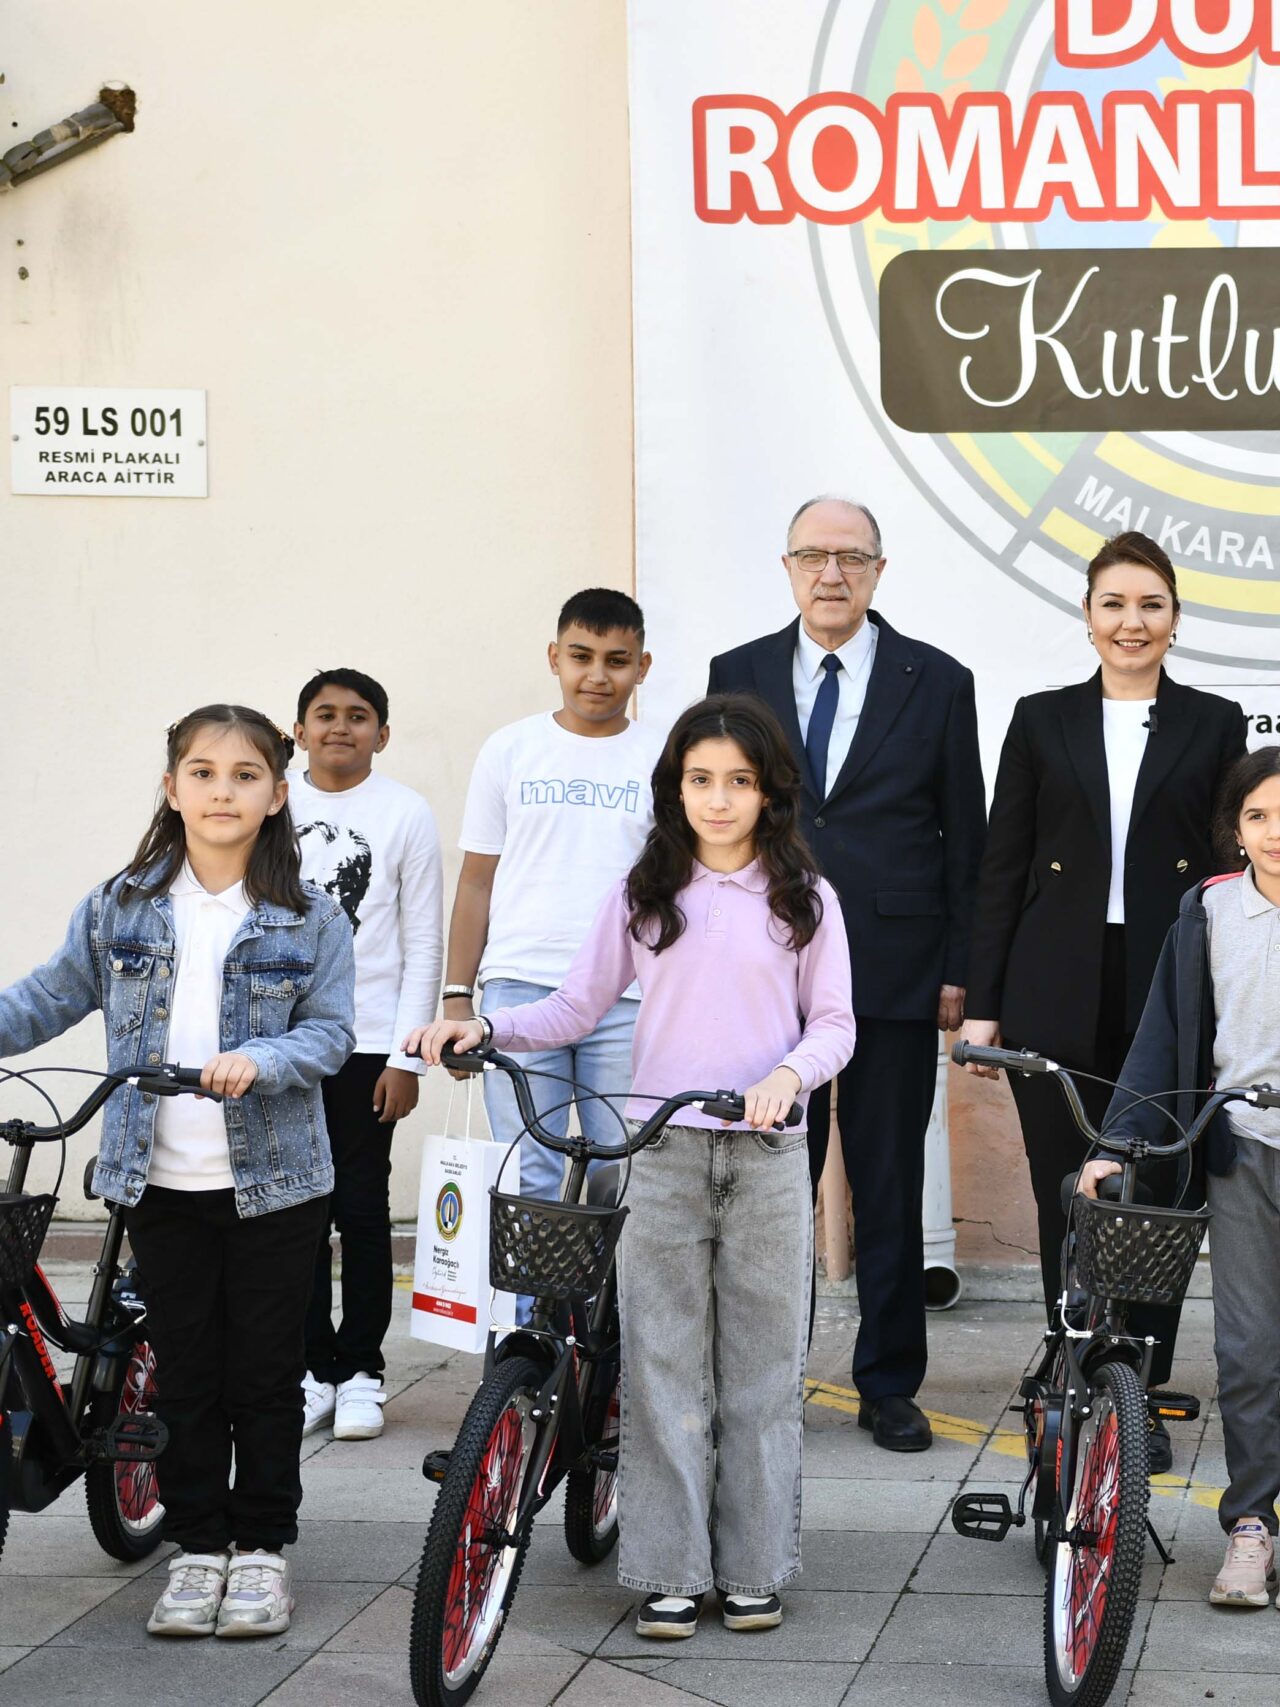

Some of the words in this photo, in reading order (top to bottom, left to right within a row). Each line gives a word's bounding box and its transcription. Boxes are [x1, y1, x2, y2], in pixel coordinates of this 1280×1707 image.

[34, 406, 70, 436] 59
[82, 407, 119, 437] LS
[130, 408, 182, 437] 001
[38, 449, 95, 464] RESMİ
[102, 451, 180, 465] PLAKALI
[44, 471, 108, 483] ARACA
[114, 468, 175, 484] AİTTİR
[1073, 475, 1275, 570] MALKARA
[520, 779, 640, 813] mavi
